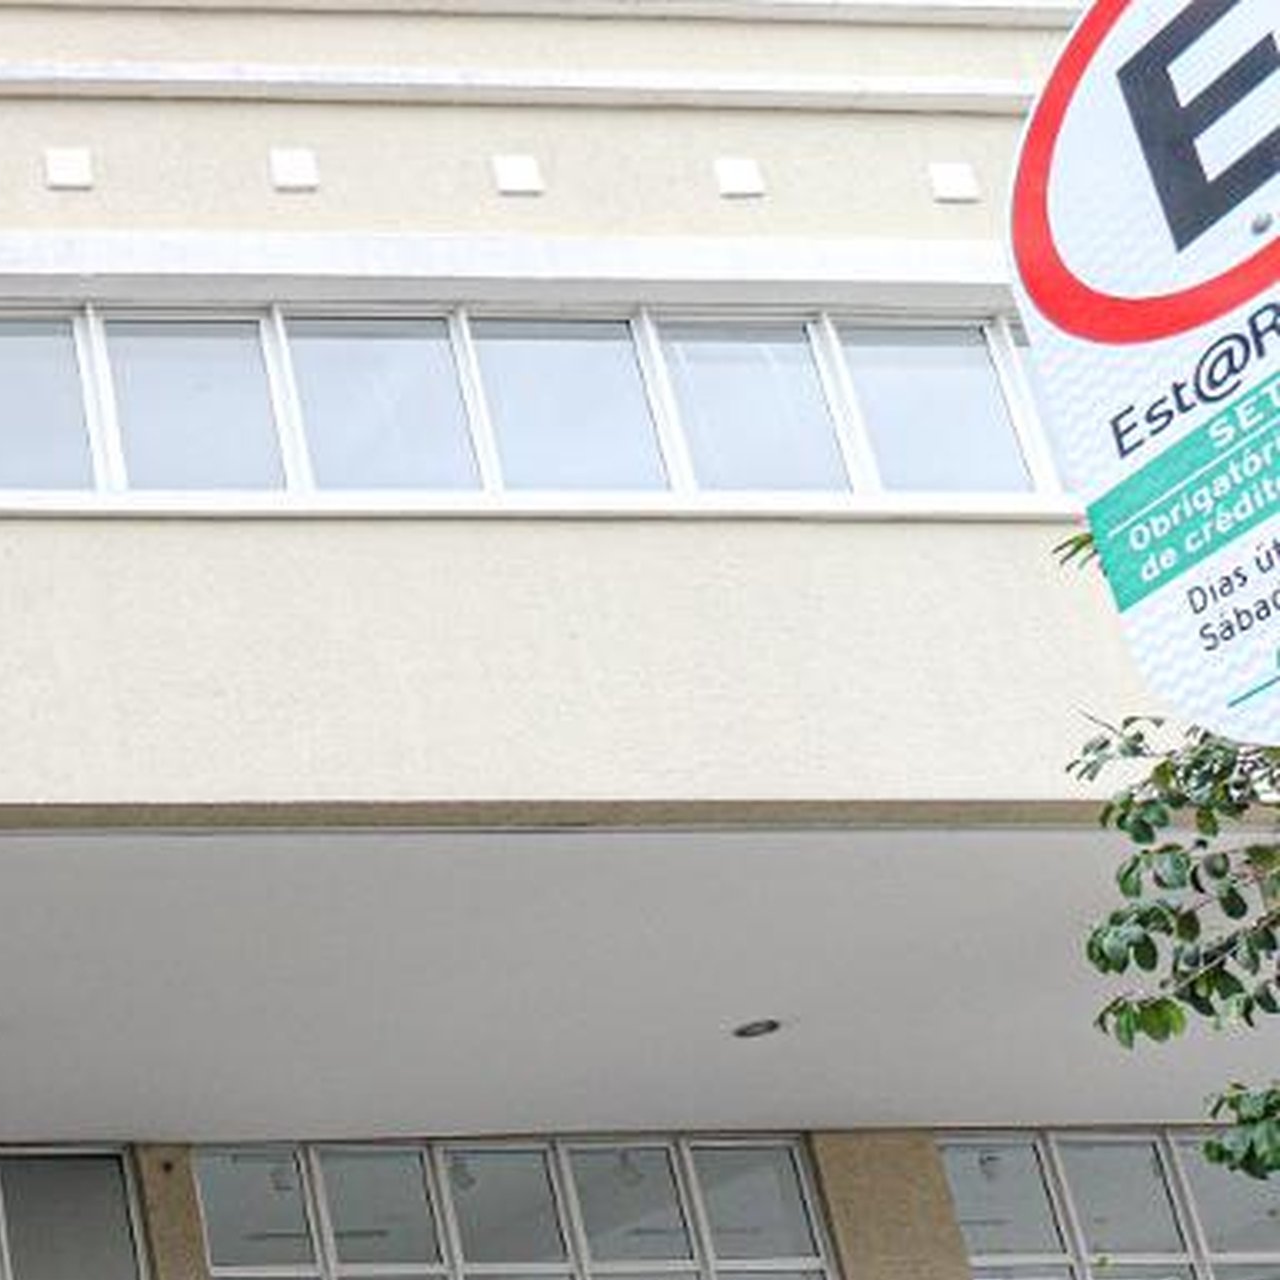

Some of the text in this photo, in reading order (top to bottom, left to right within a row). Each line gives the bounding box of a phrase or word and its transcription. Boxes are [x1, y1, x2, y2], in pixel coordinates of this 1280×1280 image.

[1116, 0, 1280, 253] E
[1142, 472, 1280, 582] de crédit
[1187, 566, 1248, 615] Dias
